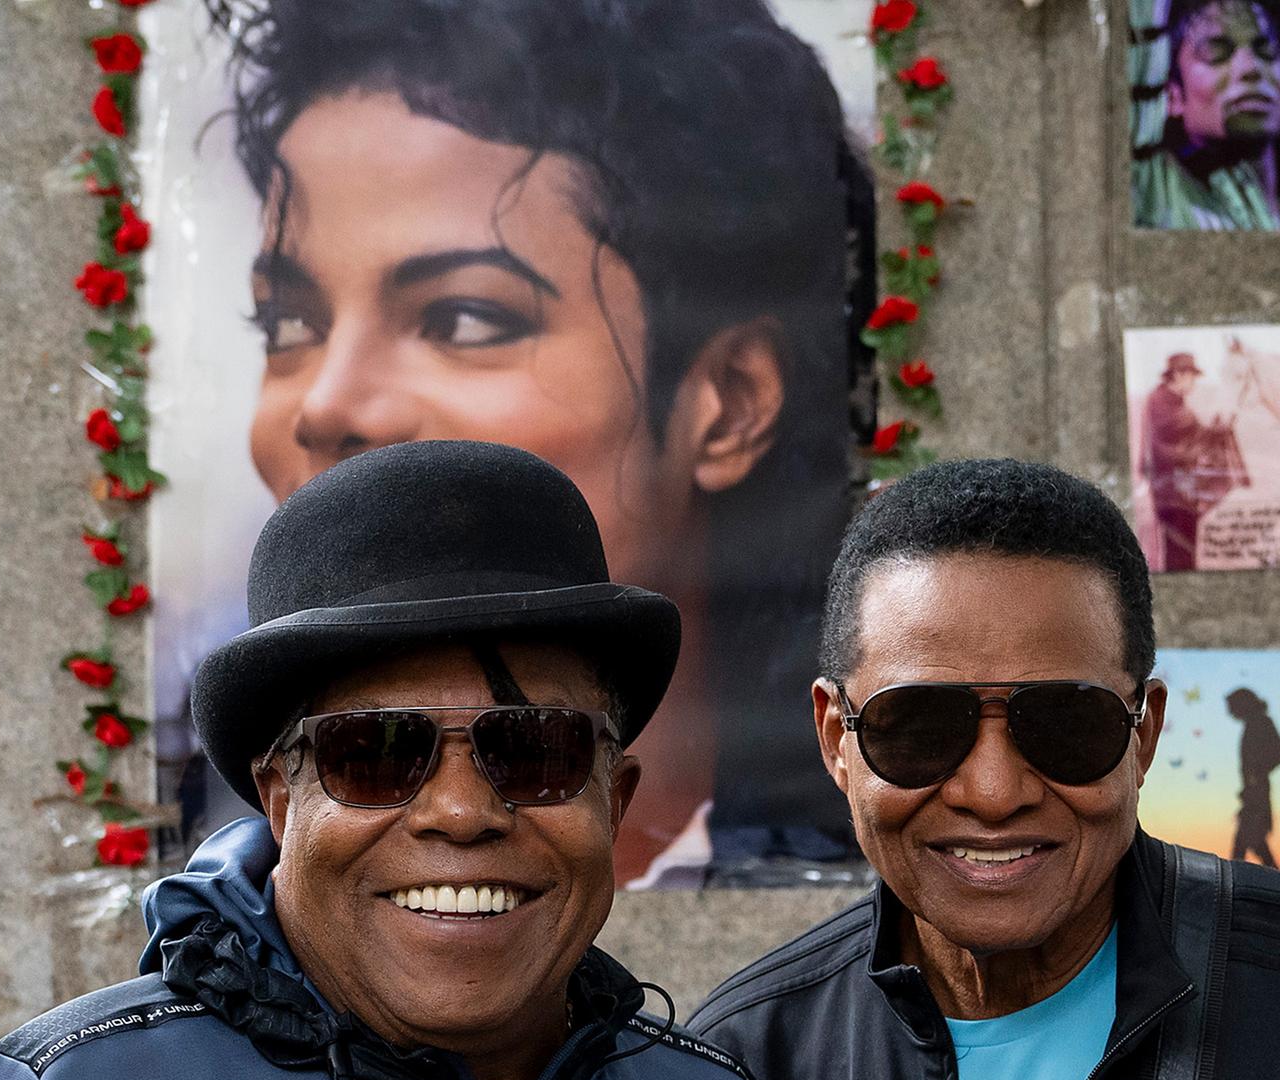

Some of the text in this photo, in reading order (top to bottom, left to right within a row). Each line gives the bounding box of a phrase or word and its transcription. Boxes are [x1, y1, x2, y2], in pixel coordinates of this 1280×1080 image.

[33, 1002, 206, 1072] UNDER ARMOUR UNDE
